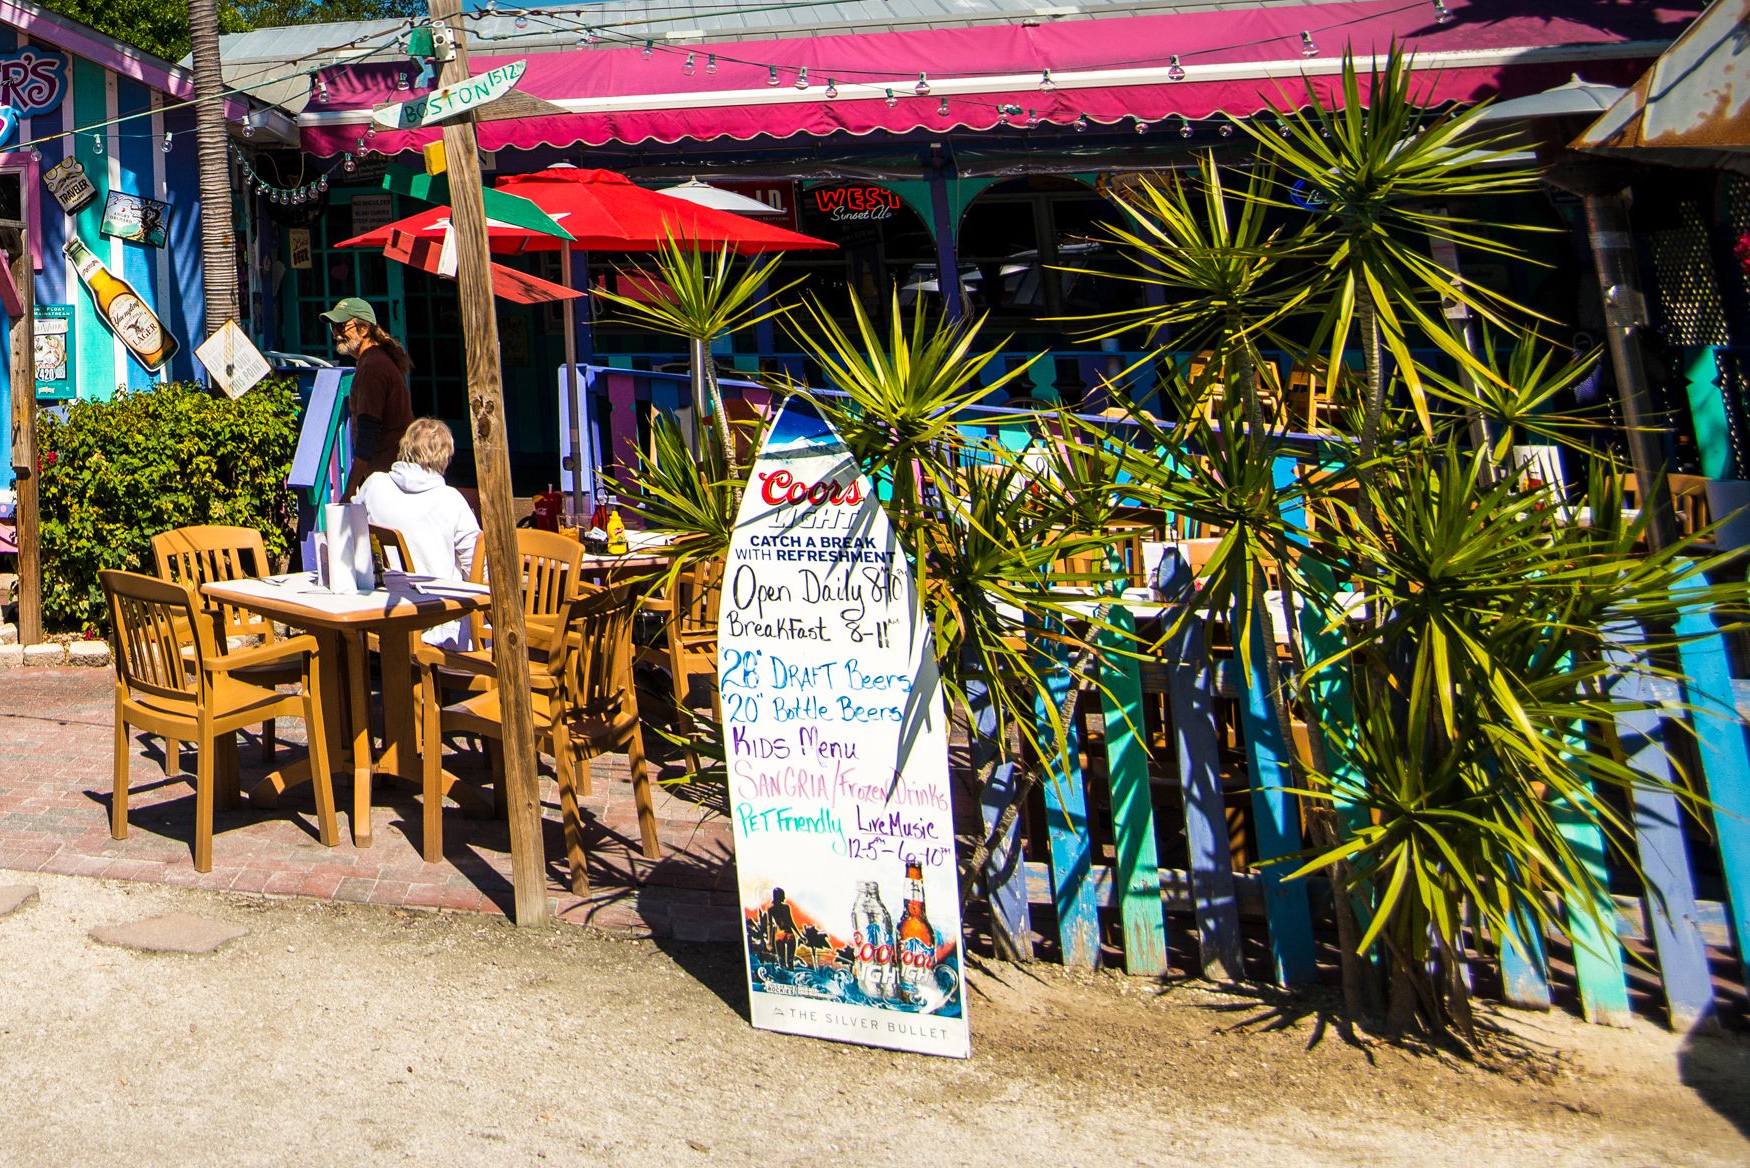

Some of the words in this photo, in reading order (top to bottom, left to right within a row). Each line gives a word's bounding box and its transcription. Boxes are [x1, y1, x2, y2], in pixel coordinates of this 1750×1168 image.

[404, 80, 490, 123] BOSTON
[487, 64, 520, 88] 1512
[58, 178, 91, 205] TRAVELER
[815, 186, 901, 212] WEST
[830, 204, 870, 222] Sunset
[132, 322, 158, 346] LAGER
[39, 368, 55, 381] 420
[758, 468, 866, 507] Coors
[768, 508, 861, 530] LIGHT
[735, 548, 772, 561] WITH
[776, 550, 896, 563] REFRESHMENT
[750, 535, 801, 549] CATCH
[806, 536, 817, 548] A
[820, 536, 876, 550] BREAK
[732, 564, 792, 619] Open
[799, 569, 866, 621] Daily
[770, 655, 838, 692] DRAFT
[844, 658, 912, 693] Beers
[772, 694, 833, 723] Bottle
[836, 695, 904, 723] Beers
[732, 725, 790, 759] KIDS
[799, 726, 859, 768] Menu
[890, 766, 949, 812] Drinks
[776, 806, 848, 856] Friendly
[856, 805, 886, 834] Live
[888, 811, 939, 839] Music
[767, 986, 794, 995] ROCKIES
[790, 1008, 818, 1022] THE
[825, 1014, 879, 1031] SILVER
[887, 1022, 948, 1040] BULLET
